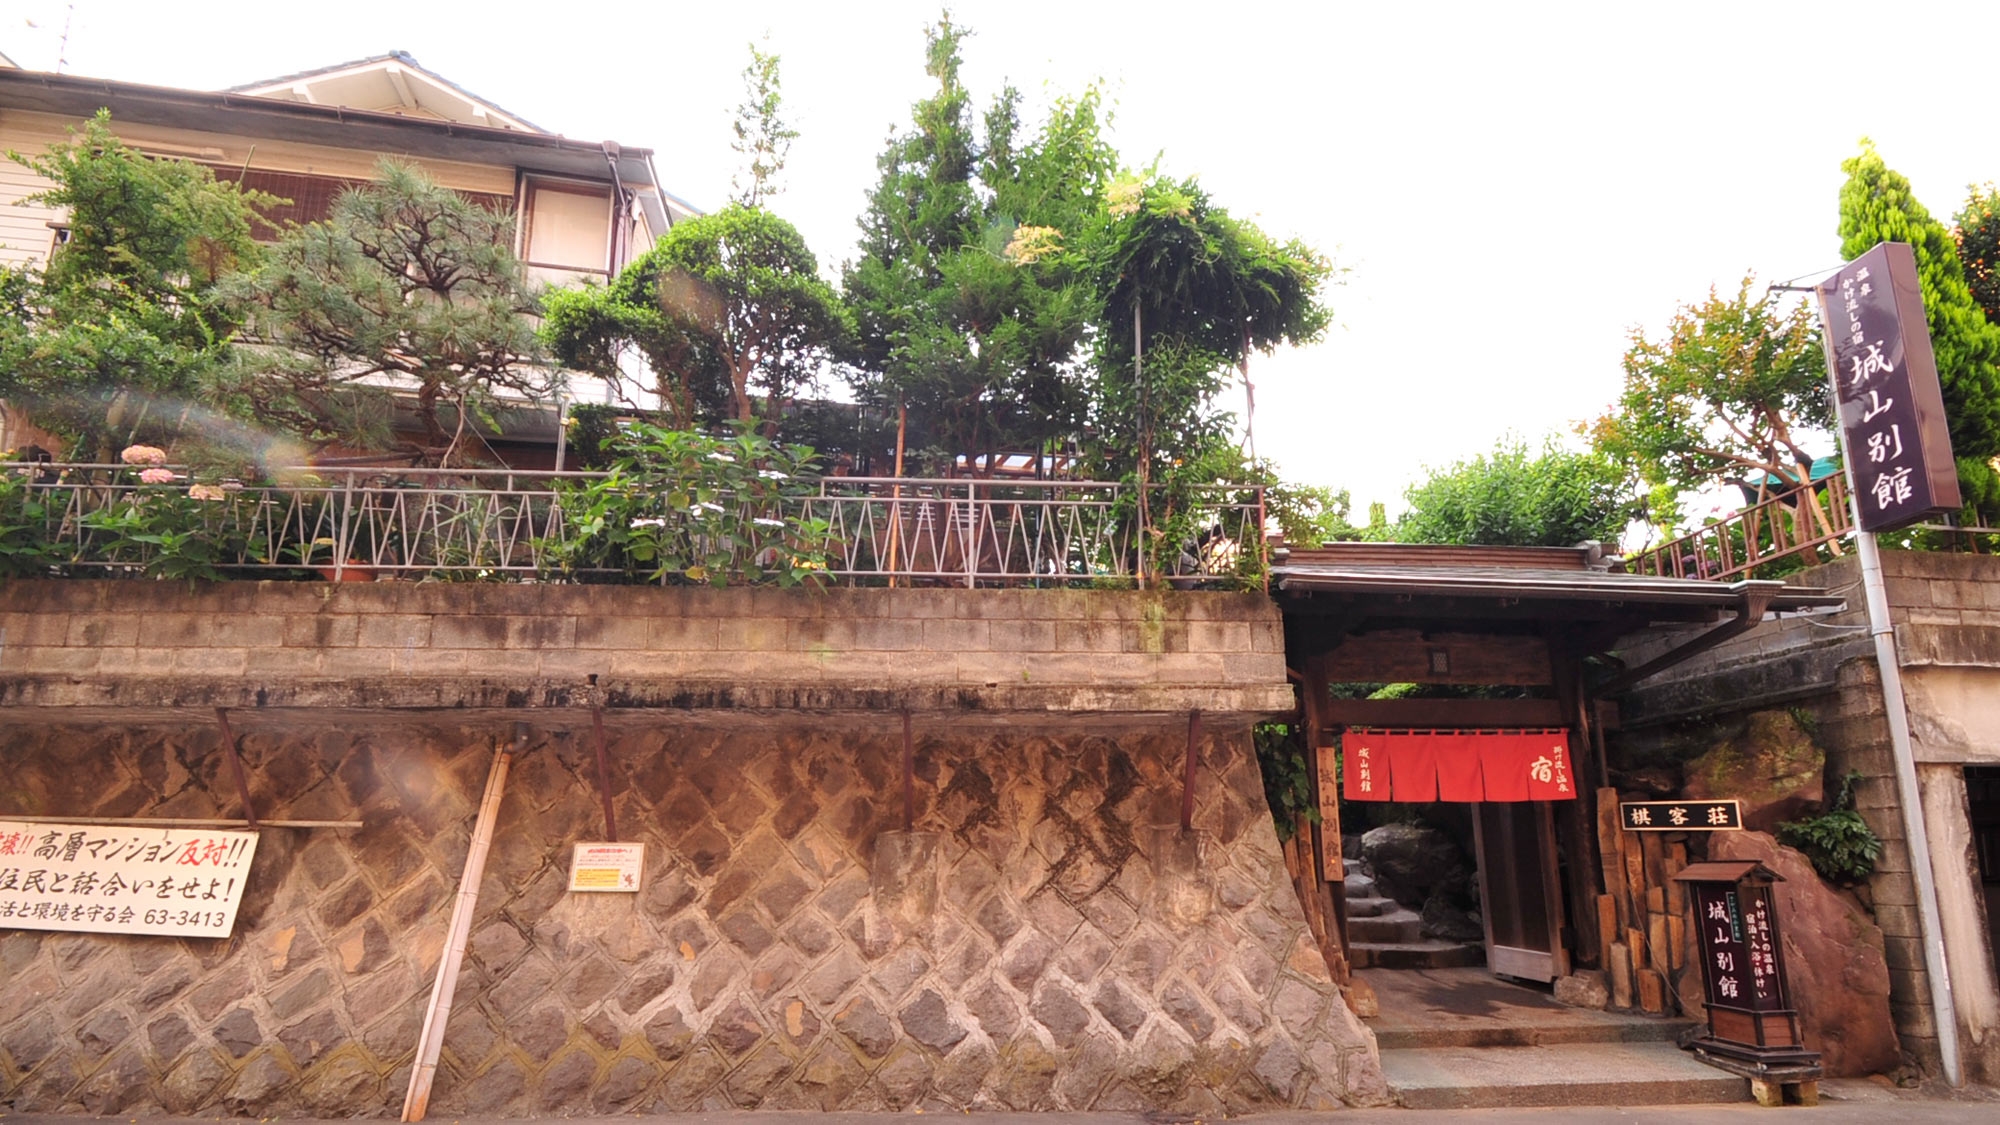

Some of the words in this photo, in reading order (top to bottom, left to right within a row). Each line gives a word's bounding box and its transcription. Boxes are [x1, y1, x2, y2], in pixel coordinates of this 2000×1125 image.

[1850, 340, 1913, 511] 城山別館
[1358, 747, 1372, 792] 城山別館
[1531, 755, 1553, 783] 宿
[144, 909, 226, 928] 63-3413
[1708, 901, 1739, 998] 城山別館
